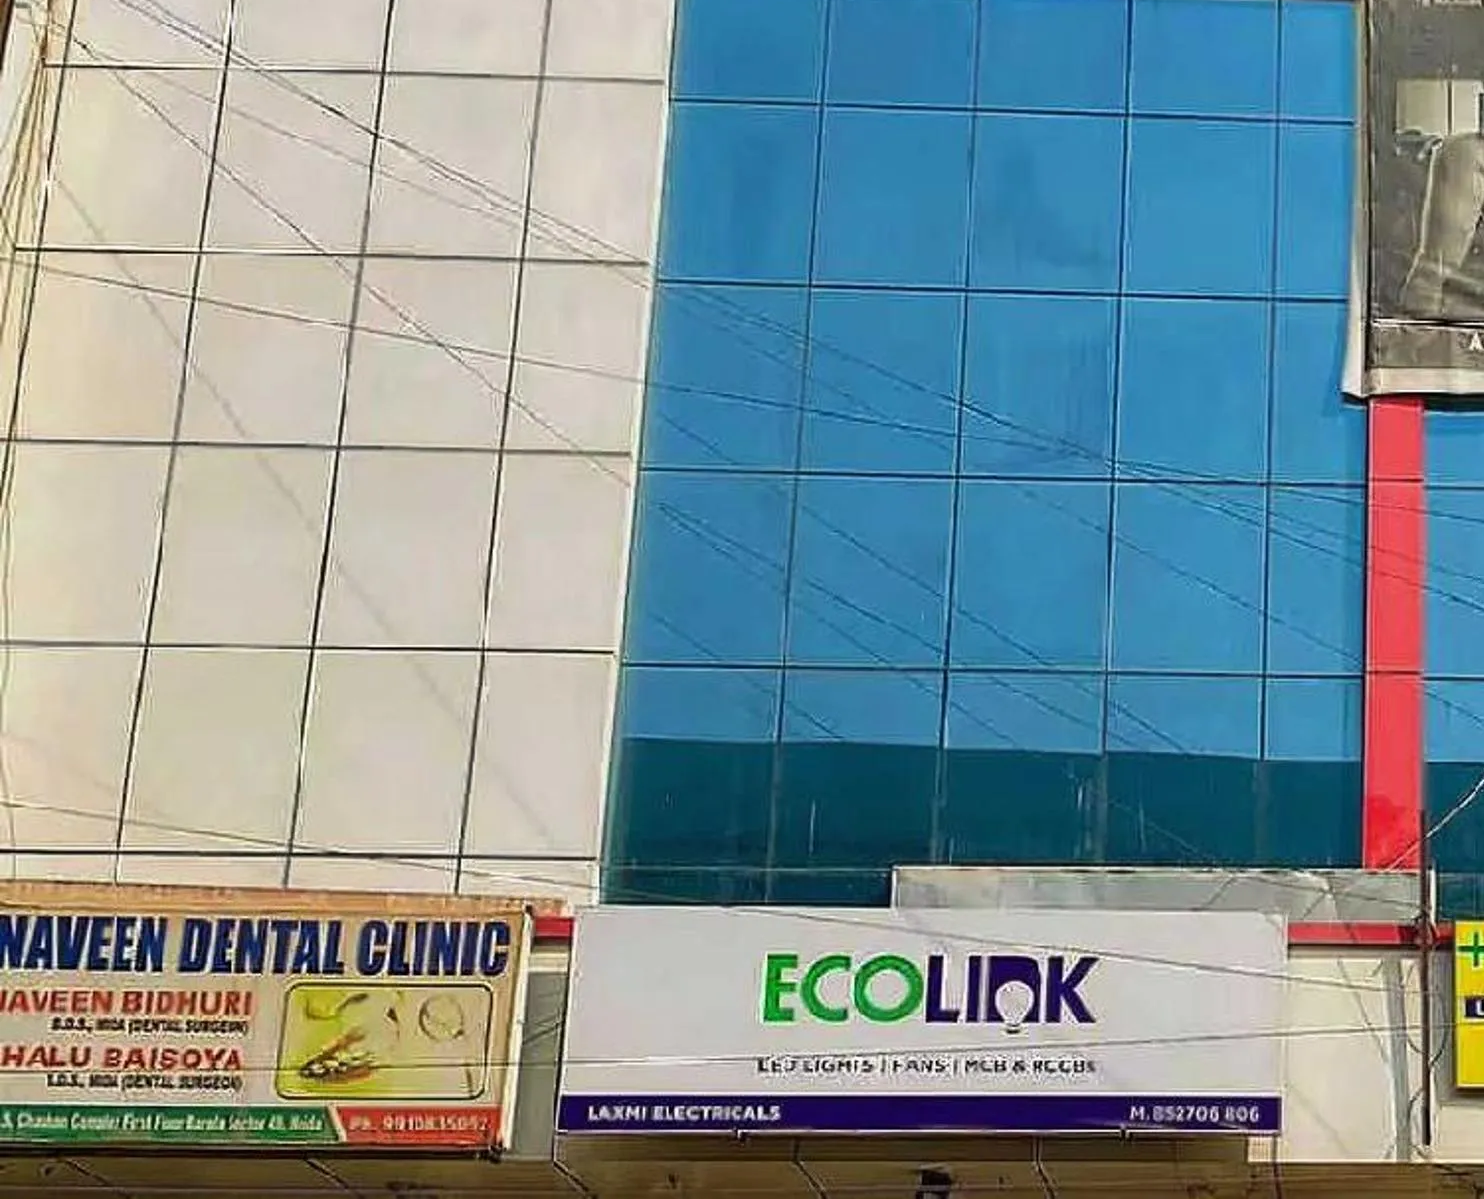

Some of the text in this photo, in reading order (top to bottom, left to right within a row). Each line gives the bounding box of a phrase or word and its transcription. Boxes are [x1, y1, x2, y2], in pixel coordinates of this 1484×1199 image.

[0, 914, 511, 978] NAVEEN DENTAL CLINIC
[763, 952, 1098, 1026] ECOLINK
[122, 991, 253, 1016] BIDHURI
[103, 1048, 242, 1070] BAISOYA
[892, 1058, 946, 1073] FANS
[587, 1104, 781, 1121] LAXMI ELECTRICALS
